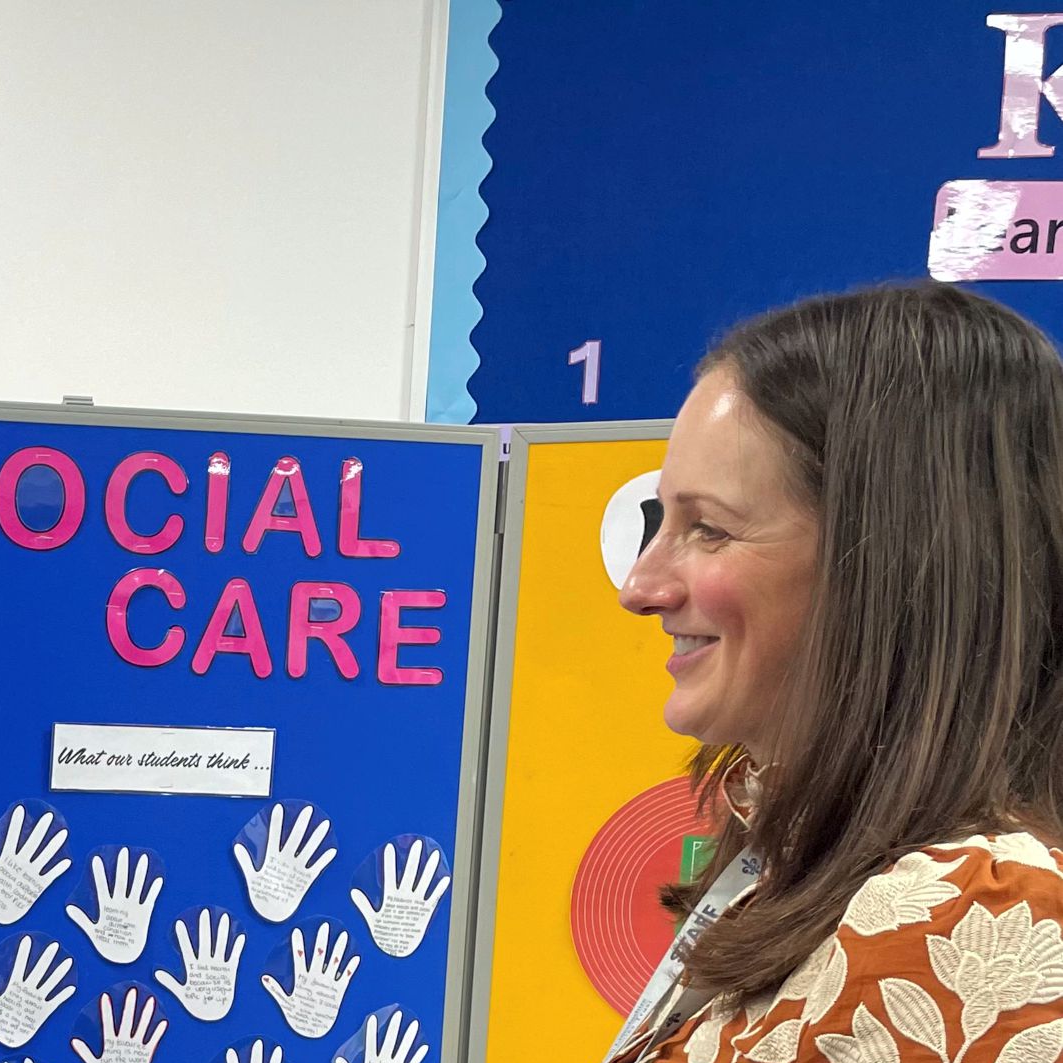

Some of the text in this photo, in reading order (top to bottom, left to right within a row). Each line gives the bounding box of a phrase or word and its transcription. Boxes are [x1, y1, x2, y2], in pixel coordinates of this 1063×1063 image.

[568, 340, 602, 404] 1
[106, 566, 448, 686] CARE
[57, 747, 107, 765] What
[106, 752, 133, 766] our
[137, 750, 201, 768] students
[205, 751, 251, 770] think
